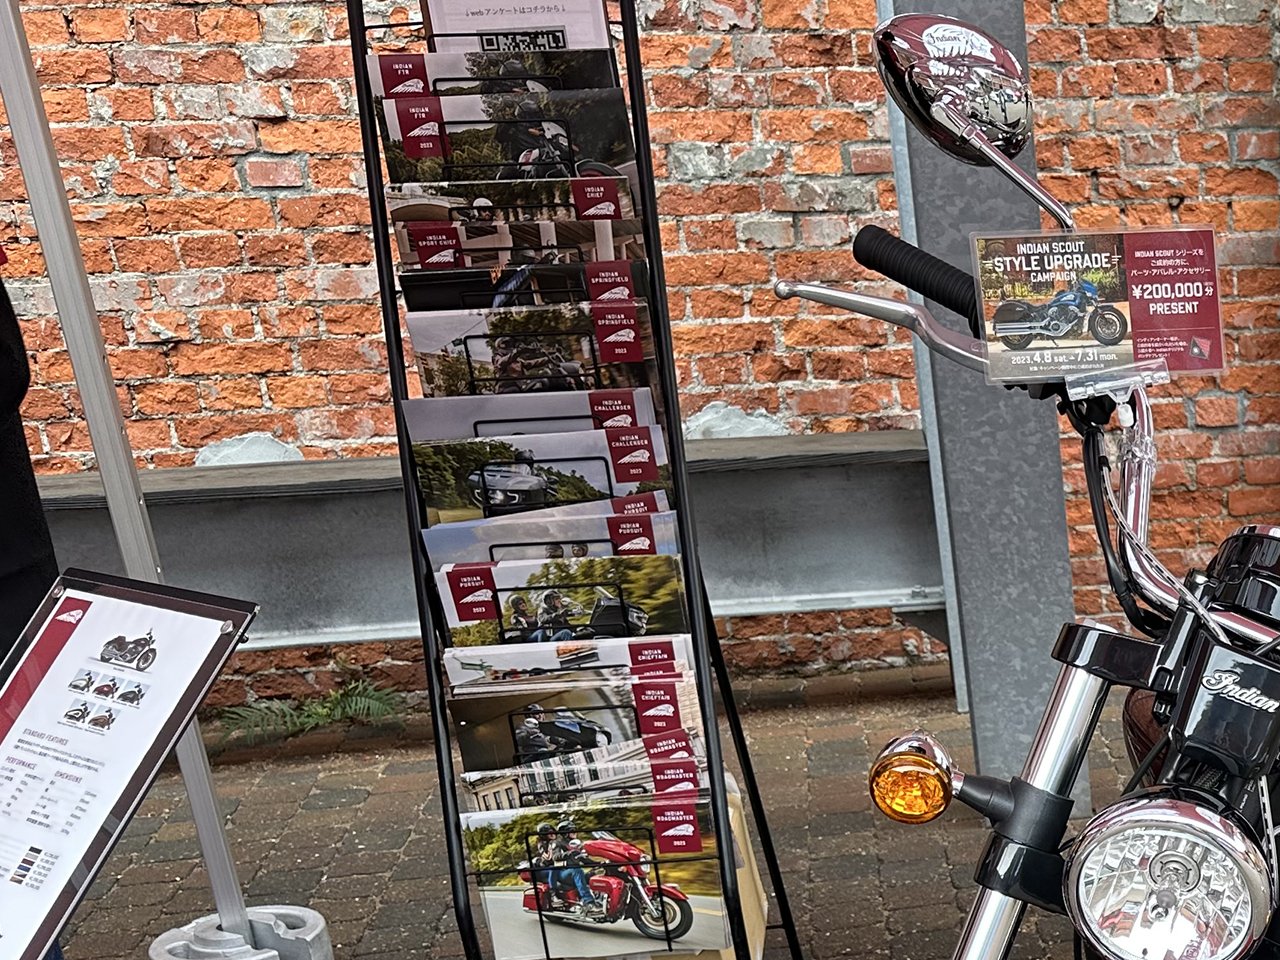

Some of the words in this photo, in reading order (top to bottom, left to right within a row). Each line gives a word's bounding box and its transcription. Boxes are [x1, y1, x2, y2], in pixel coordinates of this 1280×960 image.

[1016, 243, 1049, 254] INDIAN
[1052, 242, 1084, 253] SCOUT
[1135, 250, 1154, 258] INDIAN
[994, 256, 1041, 272] STYLE
[1044, 253, 1111, 270] UPGRADE
[1030, 271, 1077, 282] CAMPAIGN
[1149, 302, 1198, 315] PRESENT
[1075, 349, 1098, 362] 7.31
[1202, 671, 1280, 712] Indian
[657, 739, 676, 747] INDIAN
